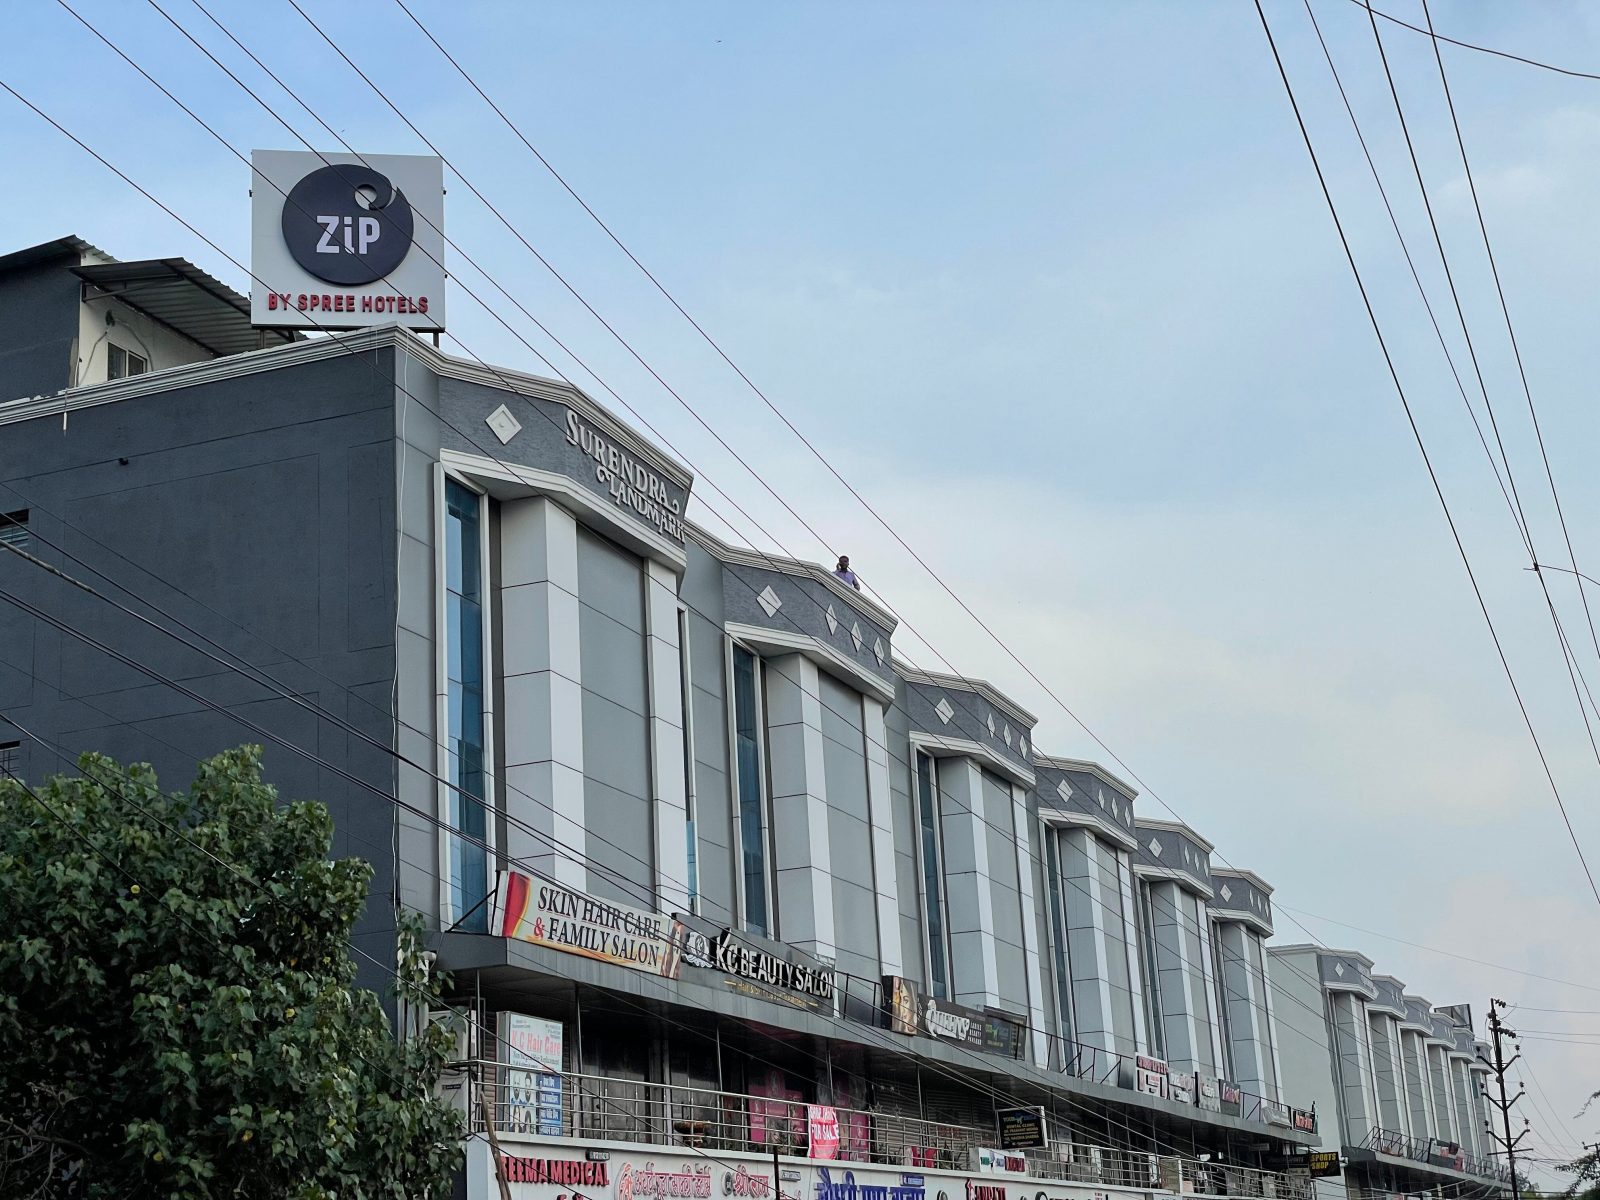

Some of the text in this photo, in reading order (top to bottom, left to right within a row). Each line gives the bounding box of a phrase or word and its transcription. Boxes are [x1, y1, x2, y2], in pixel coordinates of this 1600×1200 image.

[268, 293, 429, 314] BY SPREE HOTELS
[566, 409, 680, 515] SURENDRA
[597, 466, 686, 544] LANDMARK
[538, 886, 661, 941] SKIN HAIR CARE
[534, 916, 660, 968] & FAMILY SALON
[741, 948, 793, 987] BEAUTY
[796, 963, 834, 998] SALON
[549, 1159, 610, 1186] MEDICAL
[1311, 1153, 1337, 1162] SPORTS
[1311, 1161, 1329, 1170] SHOP
